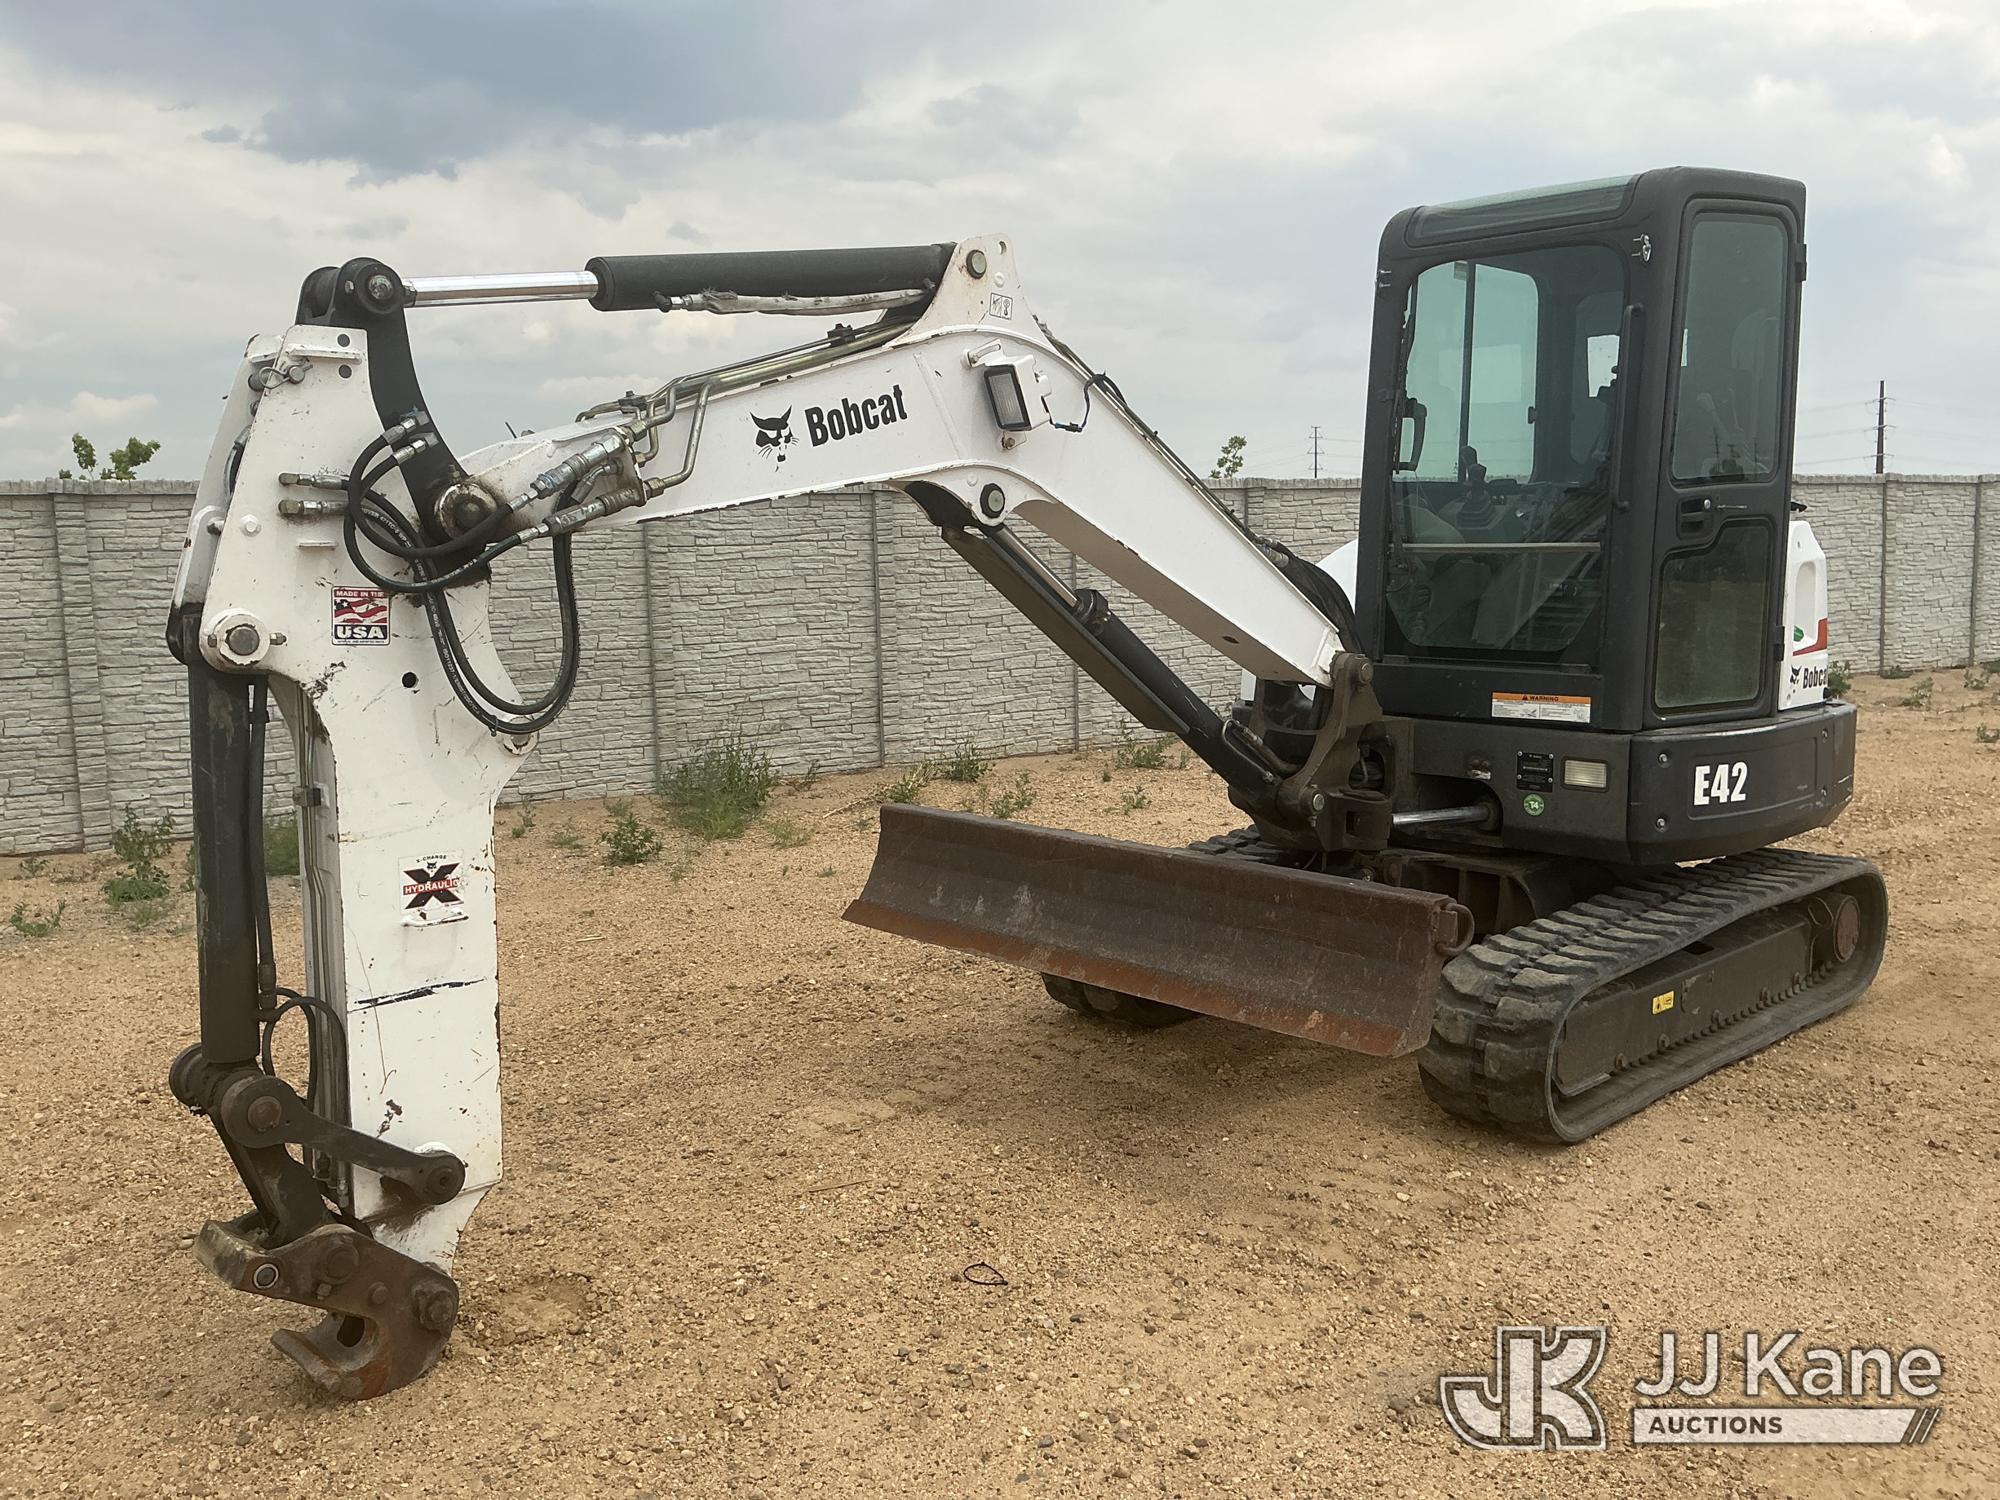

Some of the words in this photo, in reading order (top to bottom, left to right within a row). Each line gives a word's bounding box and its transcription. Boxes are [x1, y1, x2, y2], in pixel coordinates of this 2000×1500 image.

[805, 384, 907, 447] Bobcat
[336, 625, 384, 639] USA
[1803, 665, 1829, 689] Bobca
[1694, 761, 1748, 806] E42
[1529, 801, 1539, 809] T4
